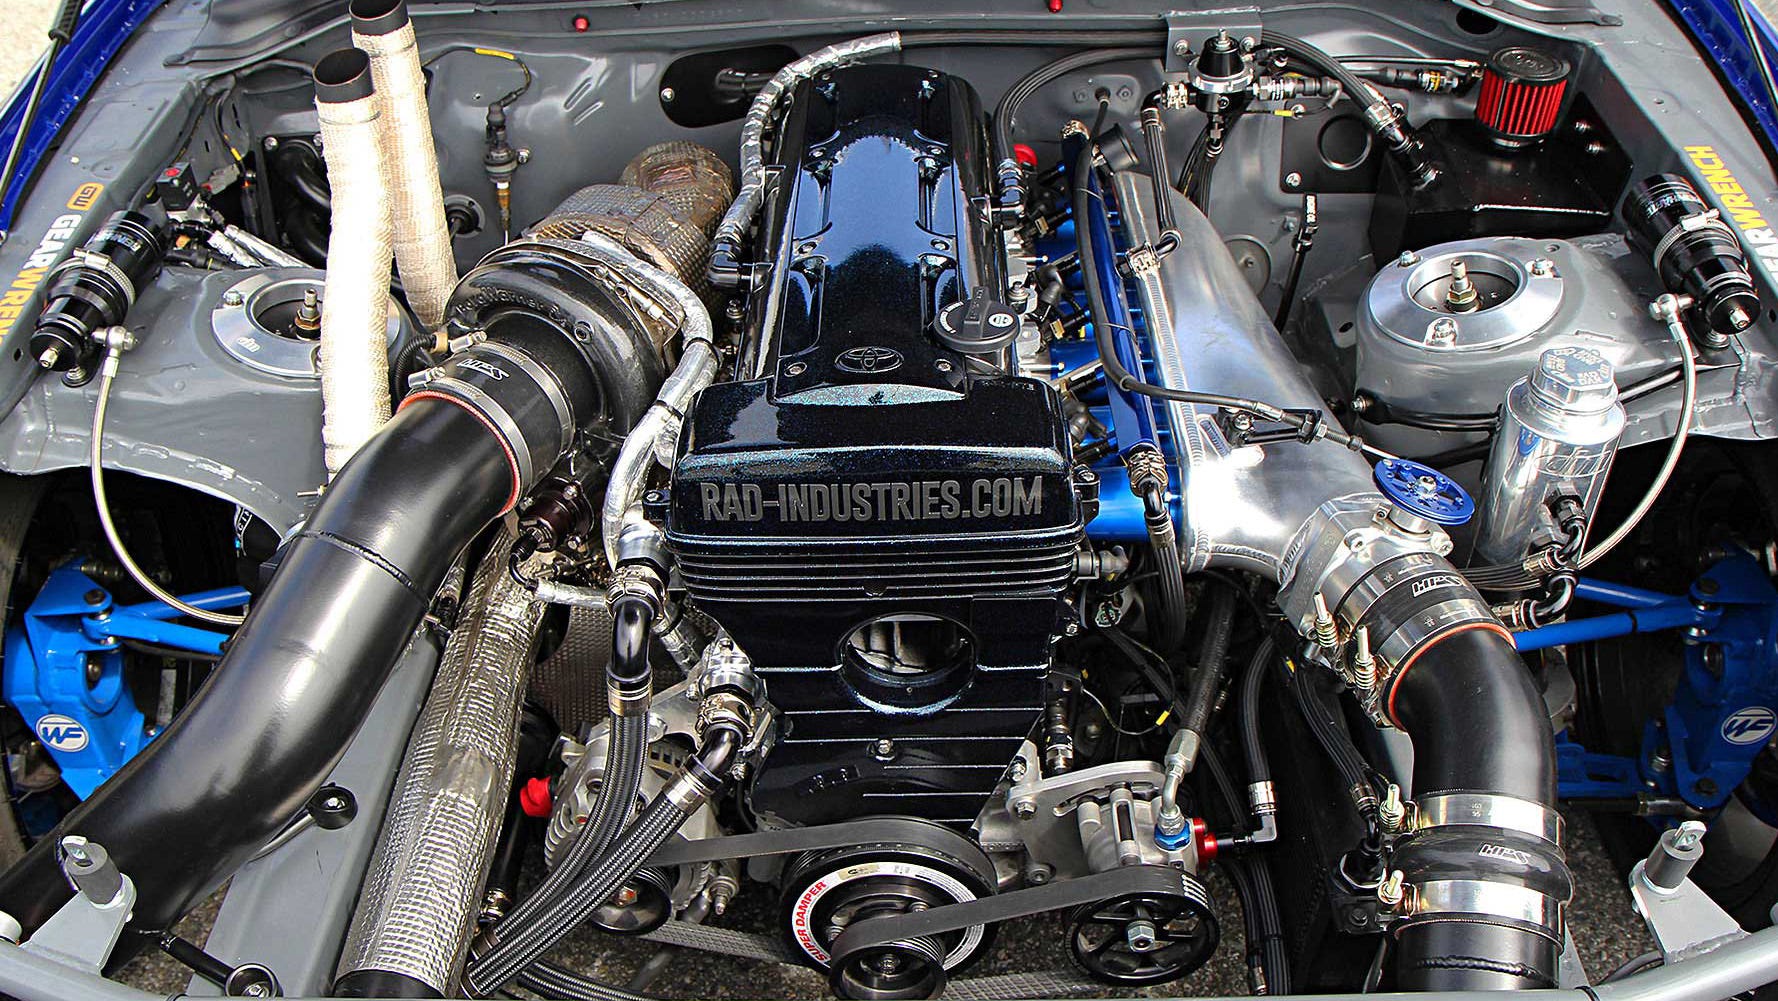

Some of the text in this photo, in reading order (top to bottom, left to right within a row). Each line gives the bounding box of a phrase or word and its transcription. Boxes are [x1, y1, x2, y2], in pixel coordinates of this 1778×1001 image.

[456, 358, 510, 381] HPS
[700, 475, 1043, 522] RAD-INDUSTRIES.COM
[1411, 574, 1464, 598] HPS
[1478, 843, 1532, 865] HPS
[796, 881, 828, 961] SUPER DAMPER
